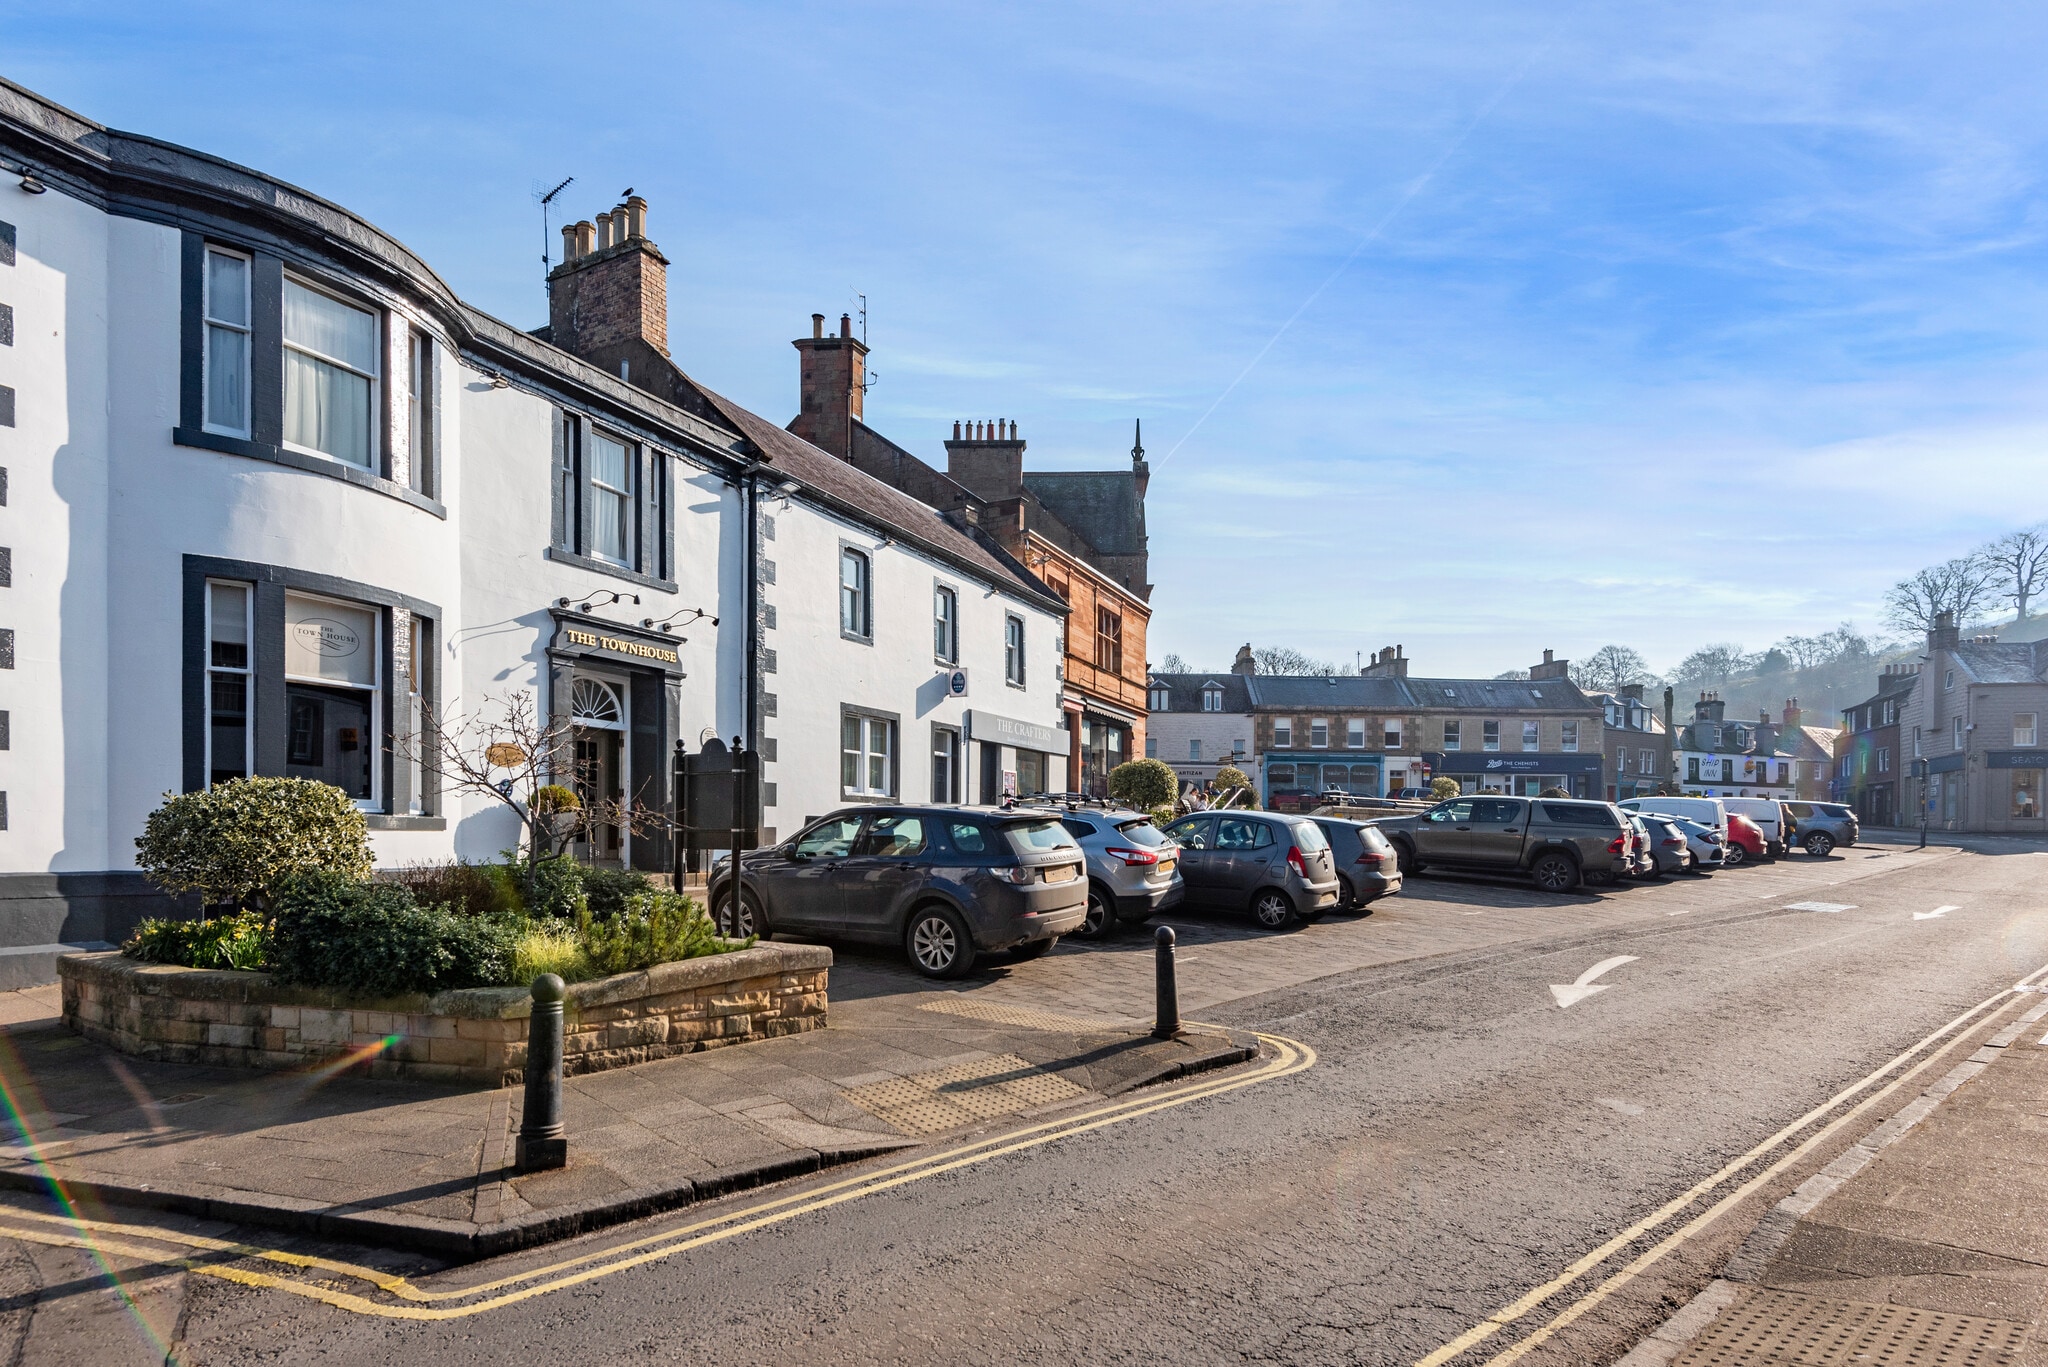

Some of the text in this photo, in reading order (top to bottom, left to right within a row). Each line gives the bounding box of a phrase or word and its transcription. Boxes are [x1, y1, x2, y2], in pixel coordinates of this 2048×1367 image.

[297, 628, 356, 643] TOWN HOUSE
[567, 629, 677, 663] THE TOWNHOUSE
[997, 719, 1013, 733] THE
[1014, 722, 1051, 742] CRAFTERS
[1703, 769, 1717, 777] INN
